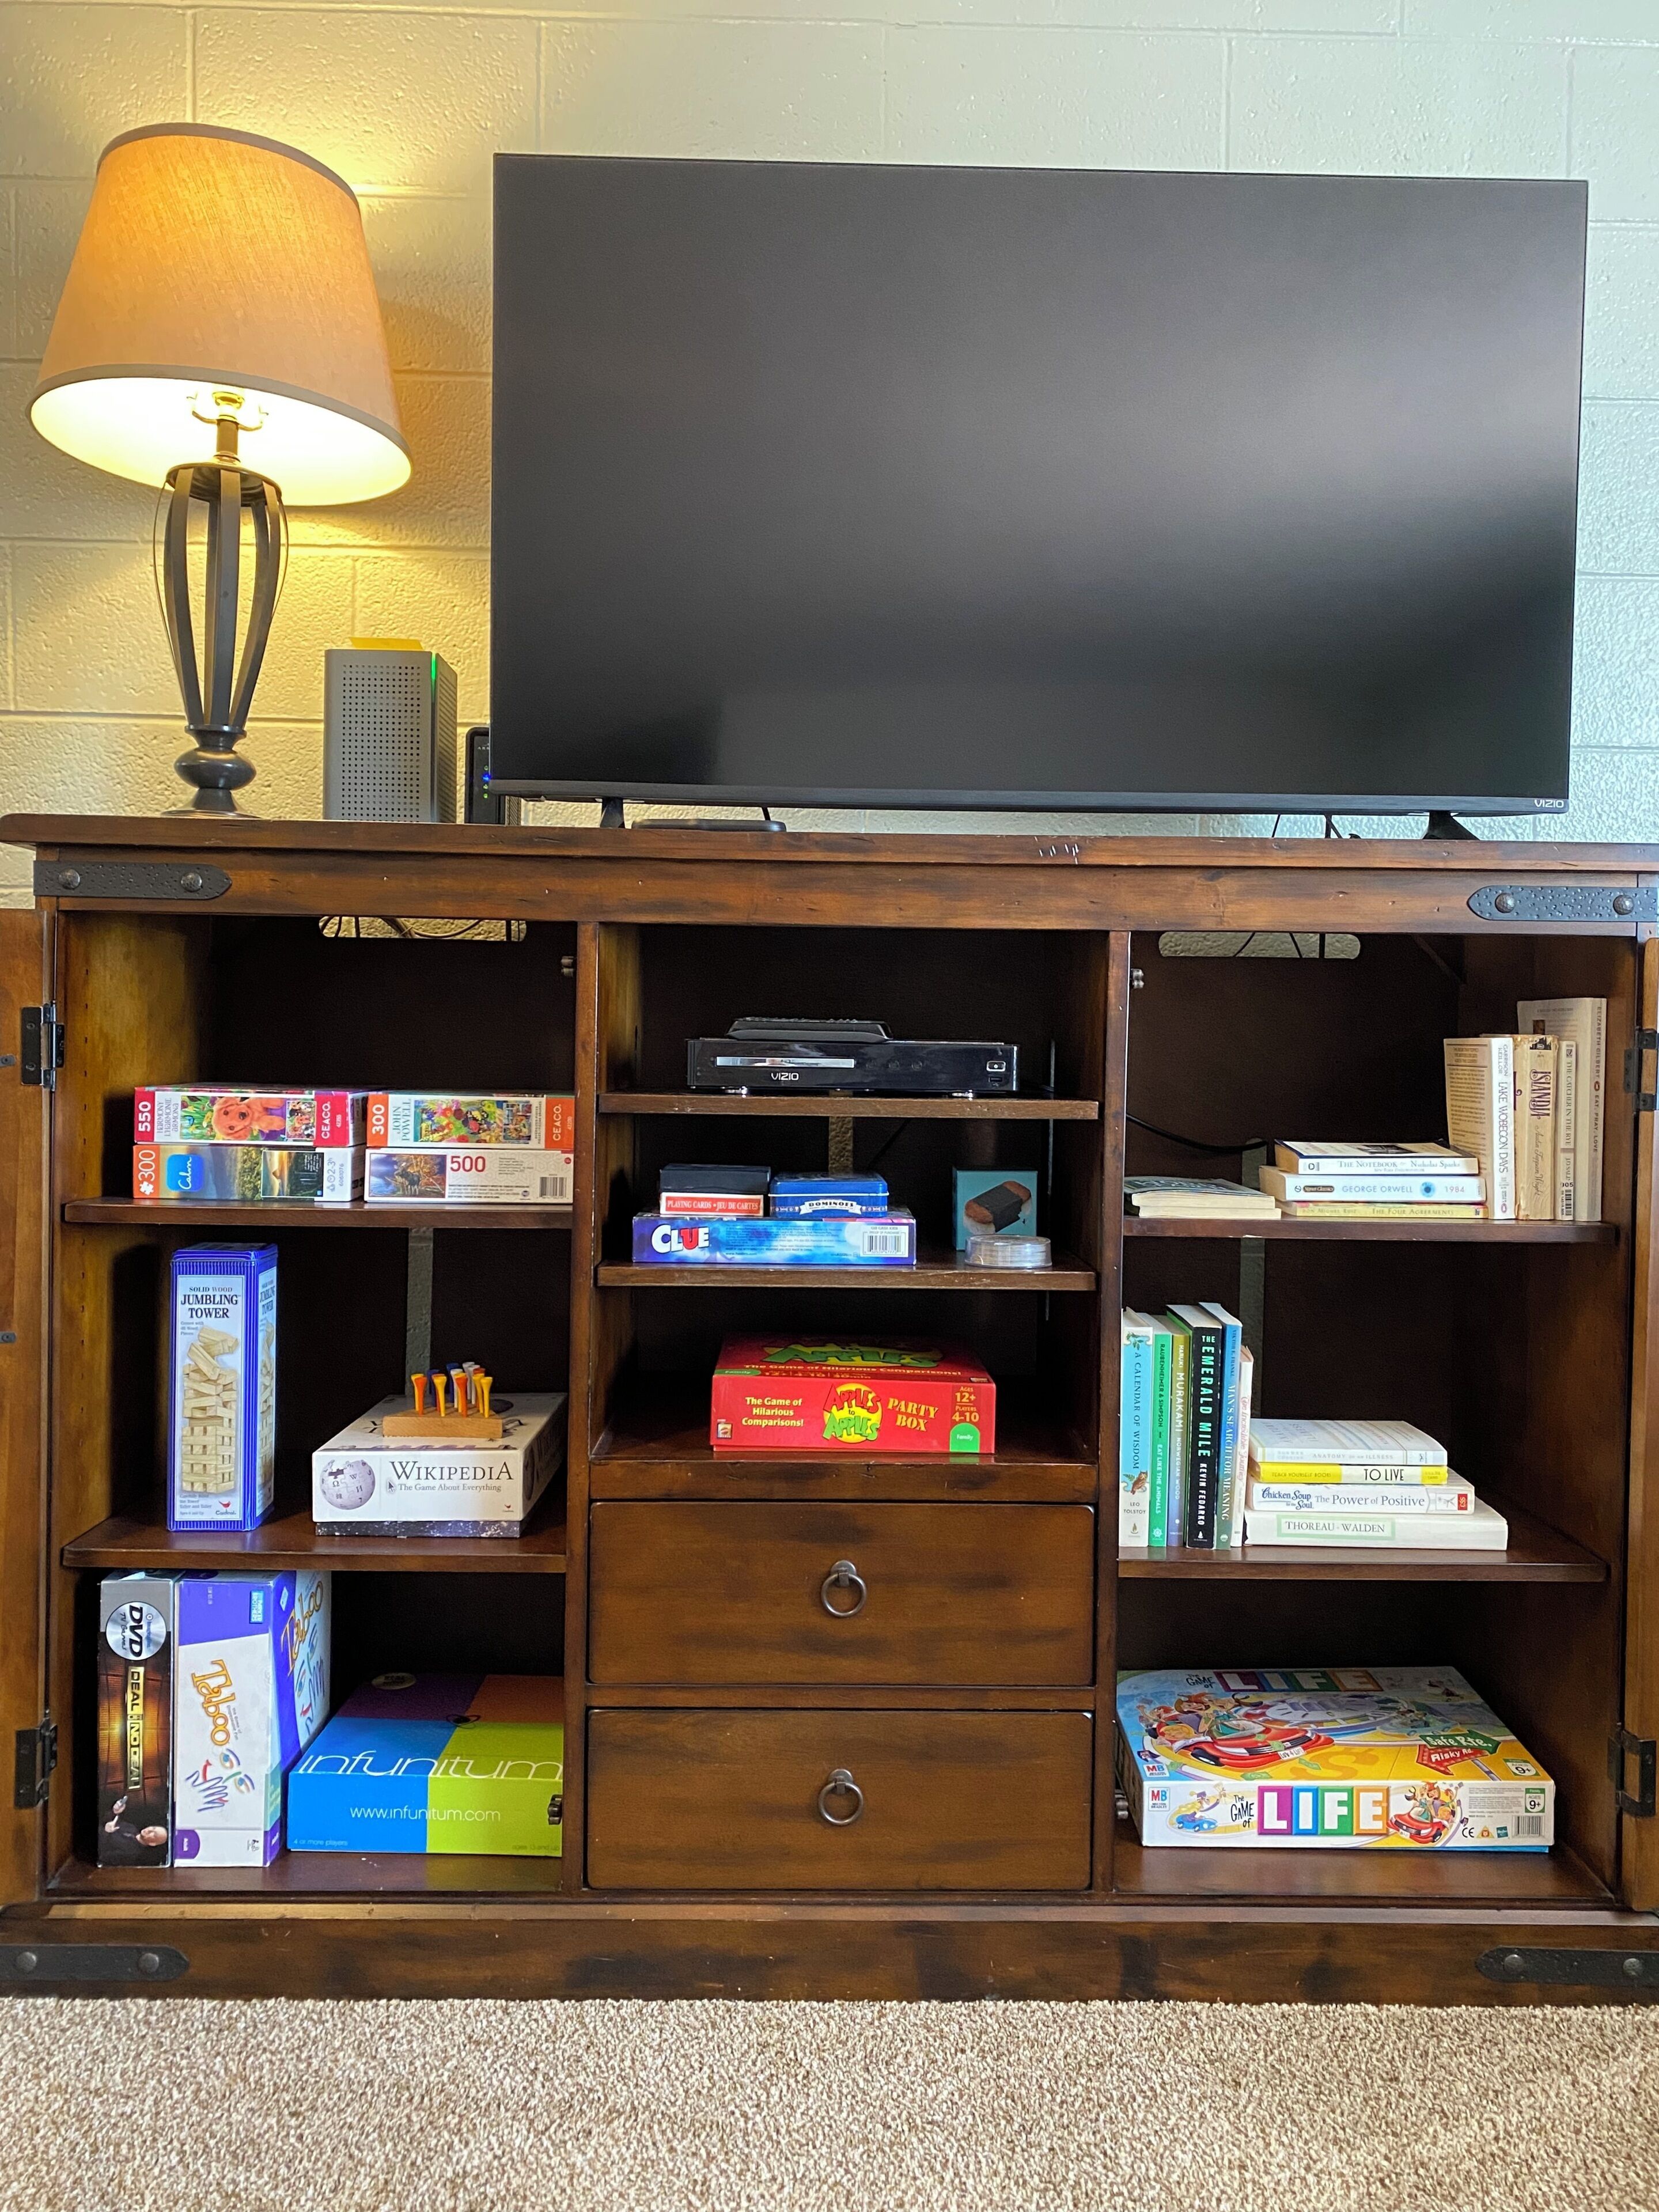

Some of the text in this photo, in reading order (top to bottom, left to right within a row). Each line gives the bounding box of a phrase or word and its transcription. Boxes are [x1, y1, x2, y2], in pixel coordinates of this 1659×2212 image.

[1534, 800, 1564, 808] VIZIO
[771, 1072, 800, 1081] VIZIO
[1498, 1082, 1508, 1103] LAKE
[138, 1101, 151, 1132] 550
[372, 1104, 384, 1135] 300
[392, 1106, 402, 1134] JOHN
[402, 1099, 411, 1141] POWELL
[1498, 1105, 1508, 1150] WOBEGON
[138, 1150, 156, 1181] 300
[450, 1156, 486, 1172] 500
[1440, 1160, 1460, 1169] Sparks
[1498, 1153, 1508, 1173] DAYS
[178, 1157, 192, 1190] Calm
[667, 1199, 759, 1211] PLAYING CARDS JEU DE CARTES
[652, 1224, 710, 1253] CLUE
[180, 1294, 238, 1305] JUMBLING
[188, 1308, 230, 1319] TOWER
[1134, 1362, 1142, 1412] CALENDAR
[1200, 1346, 1214, 1414] EMERALD
[745, 1397, 803, 1406] The Game of
[823, 1384, 882, 1414] APPLES
[955, 1392, 976, 1402] 12+
[1175, 1372, 1185, 1431] MURAKAMI
[752, 1407, 794, 1416] Hilarious
[848, 1408, 855, 1416] to
[887, 1397, 939, 1419] PARTY
[741, 1417, 804, 1427] Comparisons!
[823, 1410, 881, 1441] APPLES
[896, 1414, 929, 1432] BOX
[952, 1412, 979, 1422] 4-10
[1134, 1415, 1141, 1426] OF
[1198, 1423, 1212, 1457] MILE
[1221, 1384, 1236, 1521] MAN'S SEARCH FOR MEANING
[389, 1461, 514, 1480] WIKIPEDIA
[1237, 1450, 1248, 1480] Journey
[1364, 1469, 1404, 1481] TO LIVE
[462, 1483, 502, 1493] Everything
[1197, 1463, 1207, 1525] KEVIN FEDARKO
[1262, 1487, 1312, 1502] Chicken Soup
[1296, 1499, 1313, 1510] Soul
[1332, 1495, 1368, 1505] Power
[1370, 1496, 1378, 1504] of
[1382, 1495, 1425, 1506] Positive
[1285, 1521, 1386, 1533] THOREAU WALDEN
[120, 1612, 126, 1622] TV
[128, 1605, 143, 1657] DVD
[281, 1581, 323, 1677] Taboo
[1186, 1676, 1216, 1687] GAME
[1222, 1672, 1374, 1690] LIFE
[130, 1671, 140, 1711] DEAL
[191, 1660, 236, 1746] Taboo
[130, 1722, 141, 1746] NO
[1426, 1736, 1493, 1747] Safe Rte.
[1430, 1749, 1460, 1762] Risky
[1515, 1766, 1532, 1774] 9+
[1152, 1790, 1167, 1802] MB
[1529, 1800, 1541, 1809] 9+
[350, 1805, 501, 1822] www.infunitum.com
[1230, 1801, 1255, 1822] GAME
[1263, 1791, 1383, 1830] LIFE
[1243, 1819, 1252, 1828] of
[1462, 1827, 1475, 1838] CE
[325, 1839, 349, 1847] players
